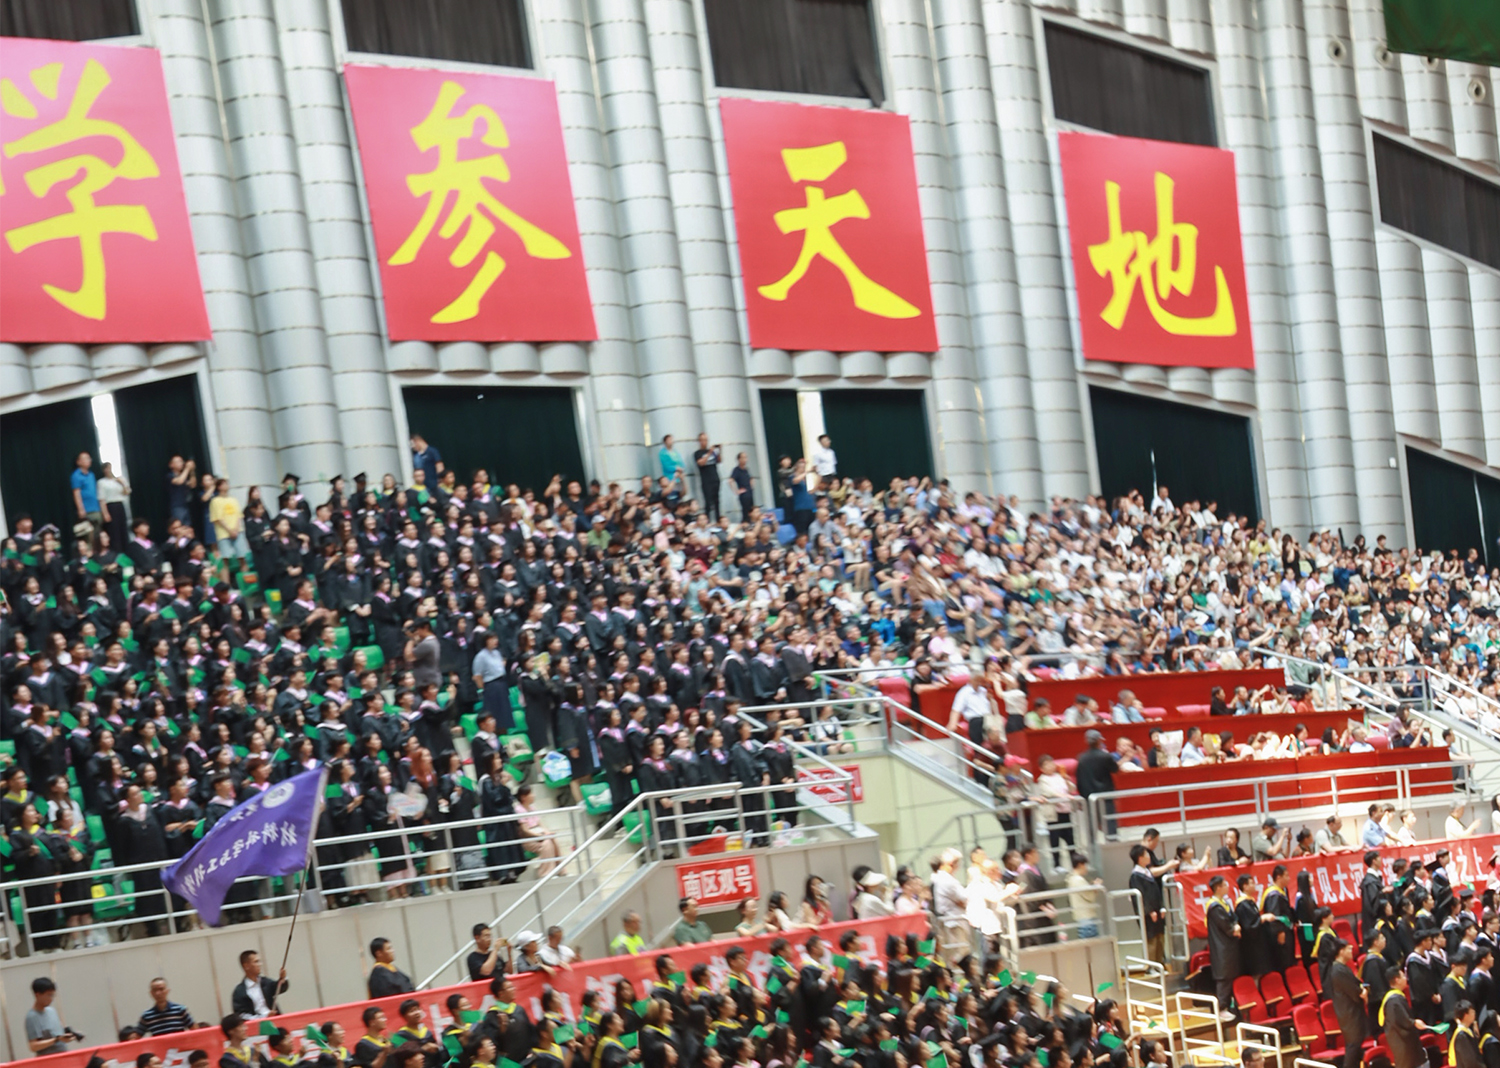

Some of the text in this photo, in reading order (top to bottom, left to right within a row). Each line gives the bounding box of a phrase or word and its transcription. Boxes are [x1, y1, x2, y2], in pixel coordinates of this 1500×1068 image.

[0, 56, 163, 321] 学
[388, 79, 573, 325] 参
[758, 141, 922, 321] 天
[1087, 171, 1237, 337] 地
[682, 865, 753, 900] 南区双号
